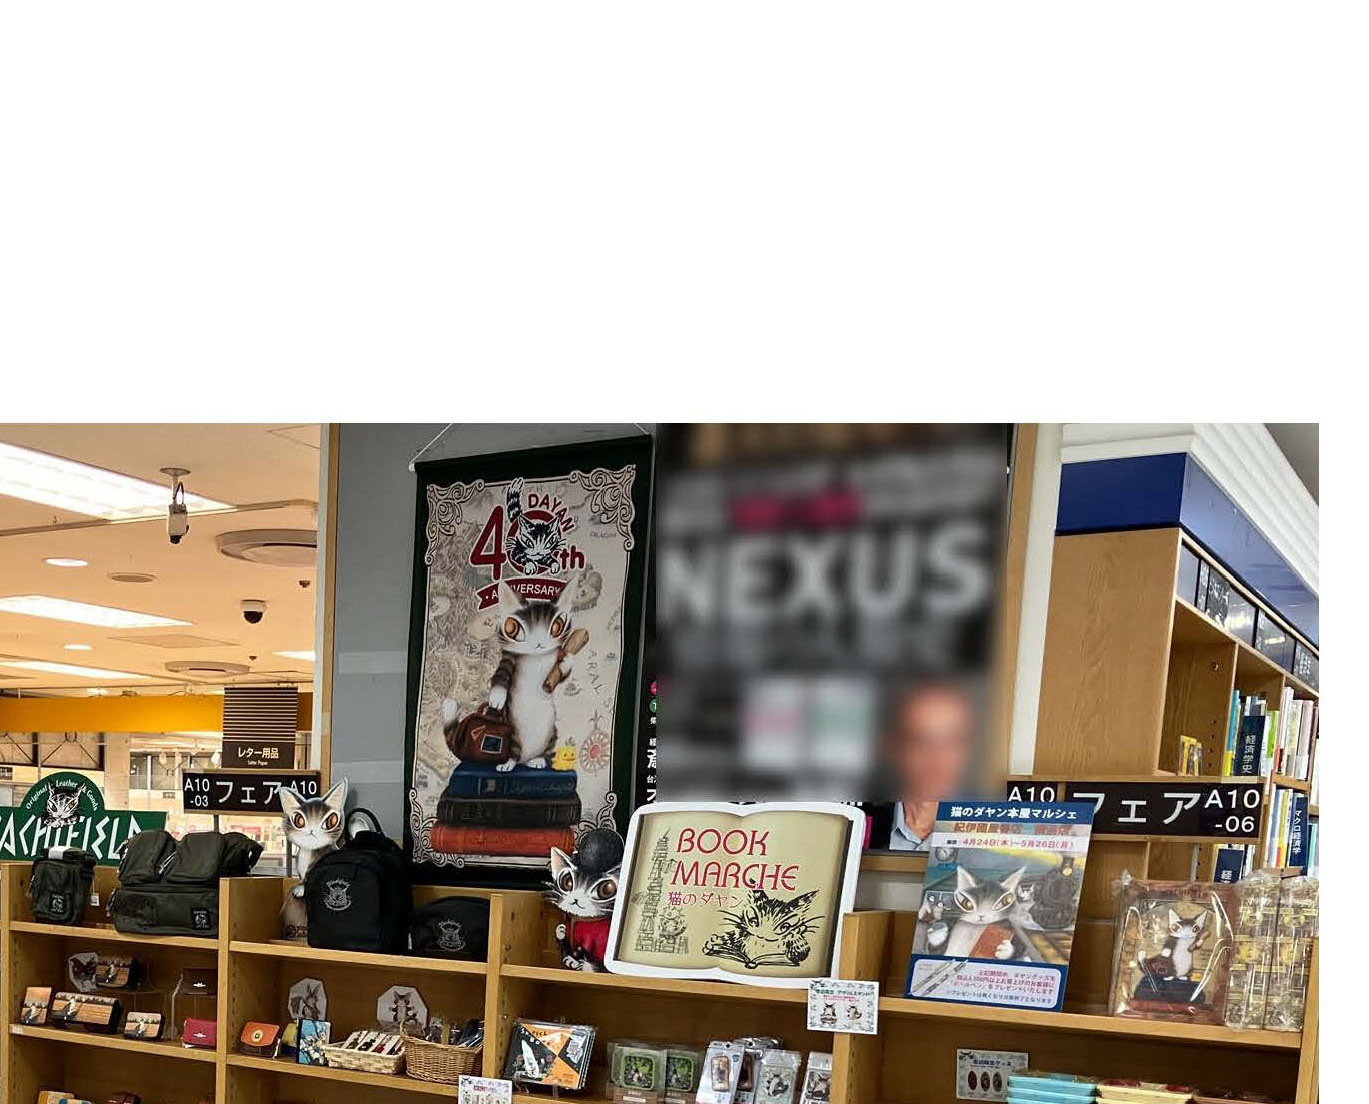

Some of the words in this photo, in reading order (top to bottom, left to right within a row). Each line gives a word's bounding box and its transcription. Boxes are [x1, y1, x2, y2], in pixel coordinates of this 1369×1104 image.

[527, 493, 574, 533] DAYAN
[662, 526, 991, 618] NEXUS
[491, 583, 561, 600] AVERSARY
[238, 747, 279, 760] レター用品
[1241, 734, 1256, 774] 経済学史
[26, 784, 48, 810] Original
[55, 779, 79, 789] Leather
[87, 789, 98, 812] Goods
[184, 777, 210, 792] A10
[216, 781, 282, 805] フェア
[290, 780, 318, 795] A10
[189, 795, 209, 807] -03
[950, 805, 1077, 820] 猫のダヤン本屋マルシェ
[1007, 786, 1055, 802] A10
[1073, 792, 1201, 825] フェア
[1204, 788, 1261, 810] A10
[1214, 815, 1256, 833] -06
[1291, 809, 1303, 855] マクロ経済学
[677, 828, 770, 856] BOOK
[670, 860, 800, 891] MARCHE
[1219, 869, 1233, 884] 経
[668, 891, 744, 909] 猫のダヤン
